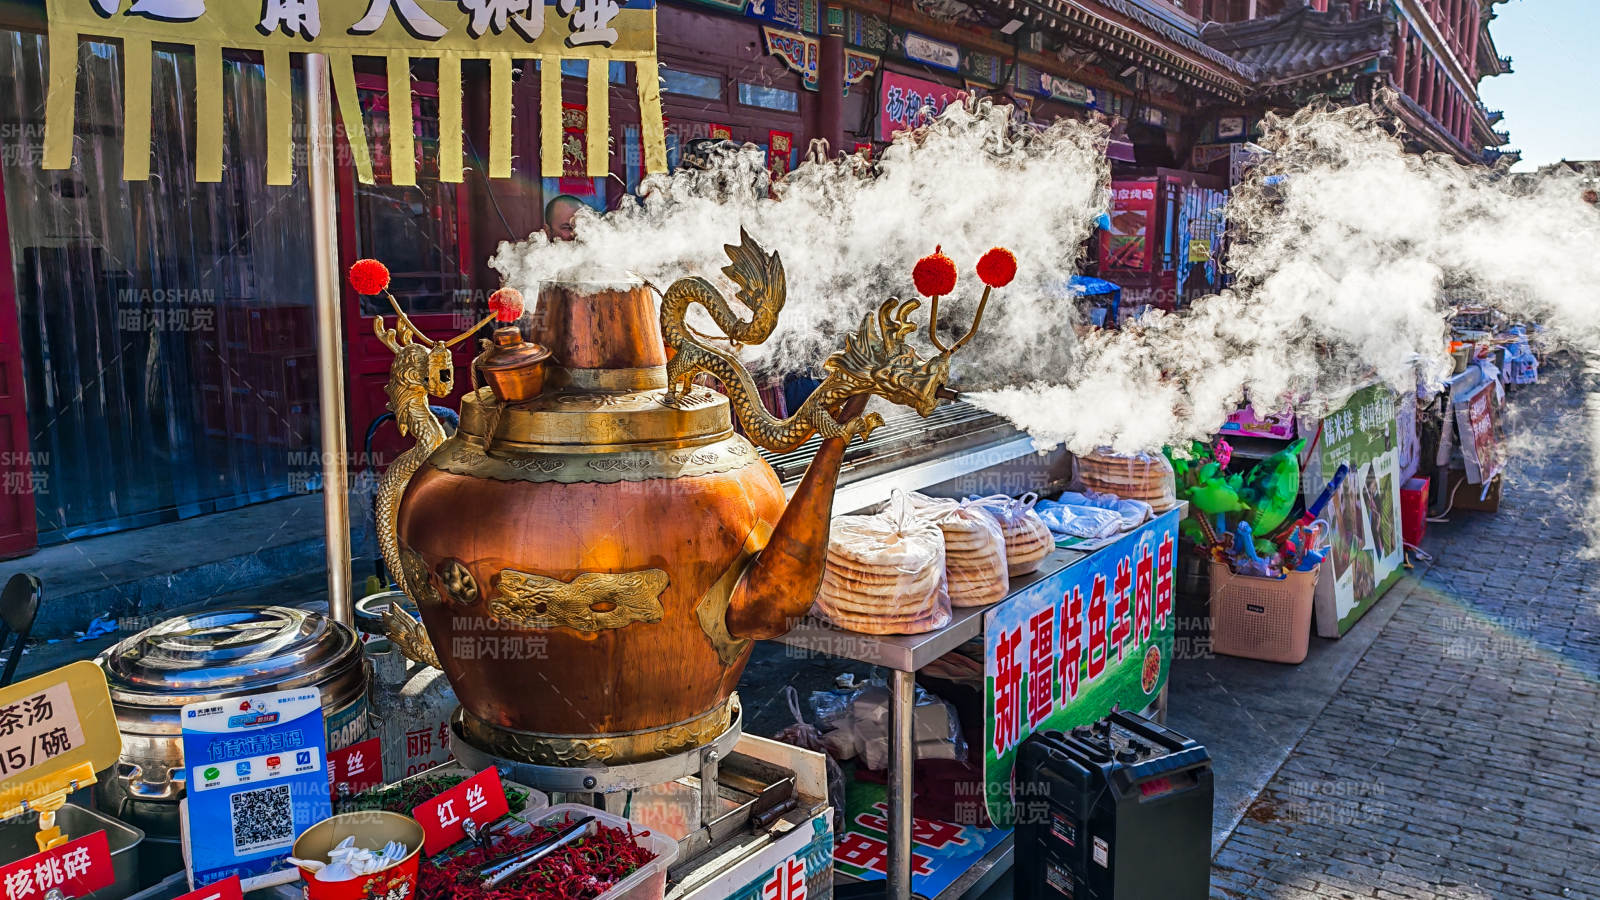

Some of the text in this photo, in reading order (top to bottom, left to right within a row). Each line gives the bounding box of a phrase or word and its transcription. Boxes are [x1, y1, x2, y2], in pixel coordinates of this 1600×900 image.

[887, 84, 948, 127] 杨柳青
[992, 530, 1174, 759] 新疆特色羊肉串
[0, 694, 53, 737] 茶汤
[207, 729, 304, 761] 付款请扫码
[437, 784, 488, 829] 红丝
[3, 846, 92, 900] 核桃碎
